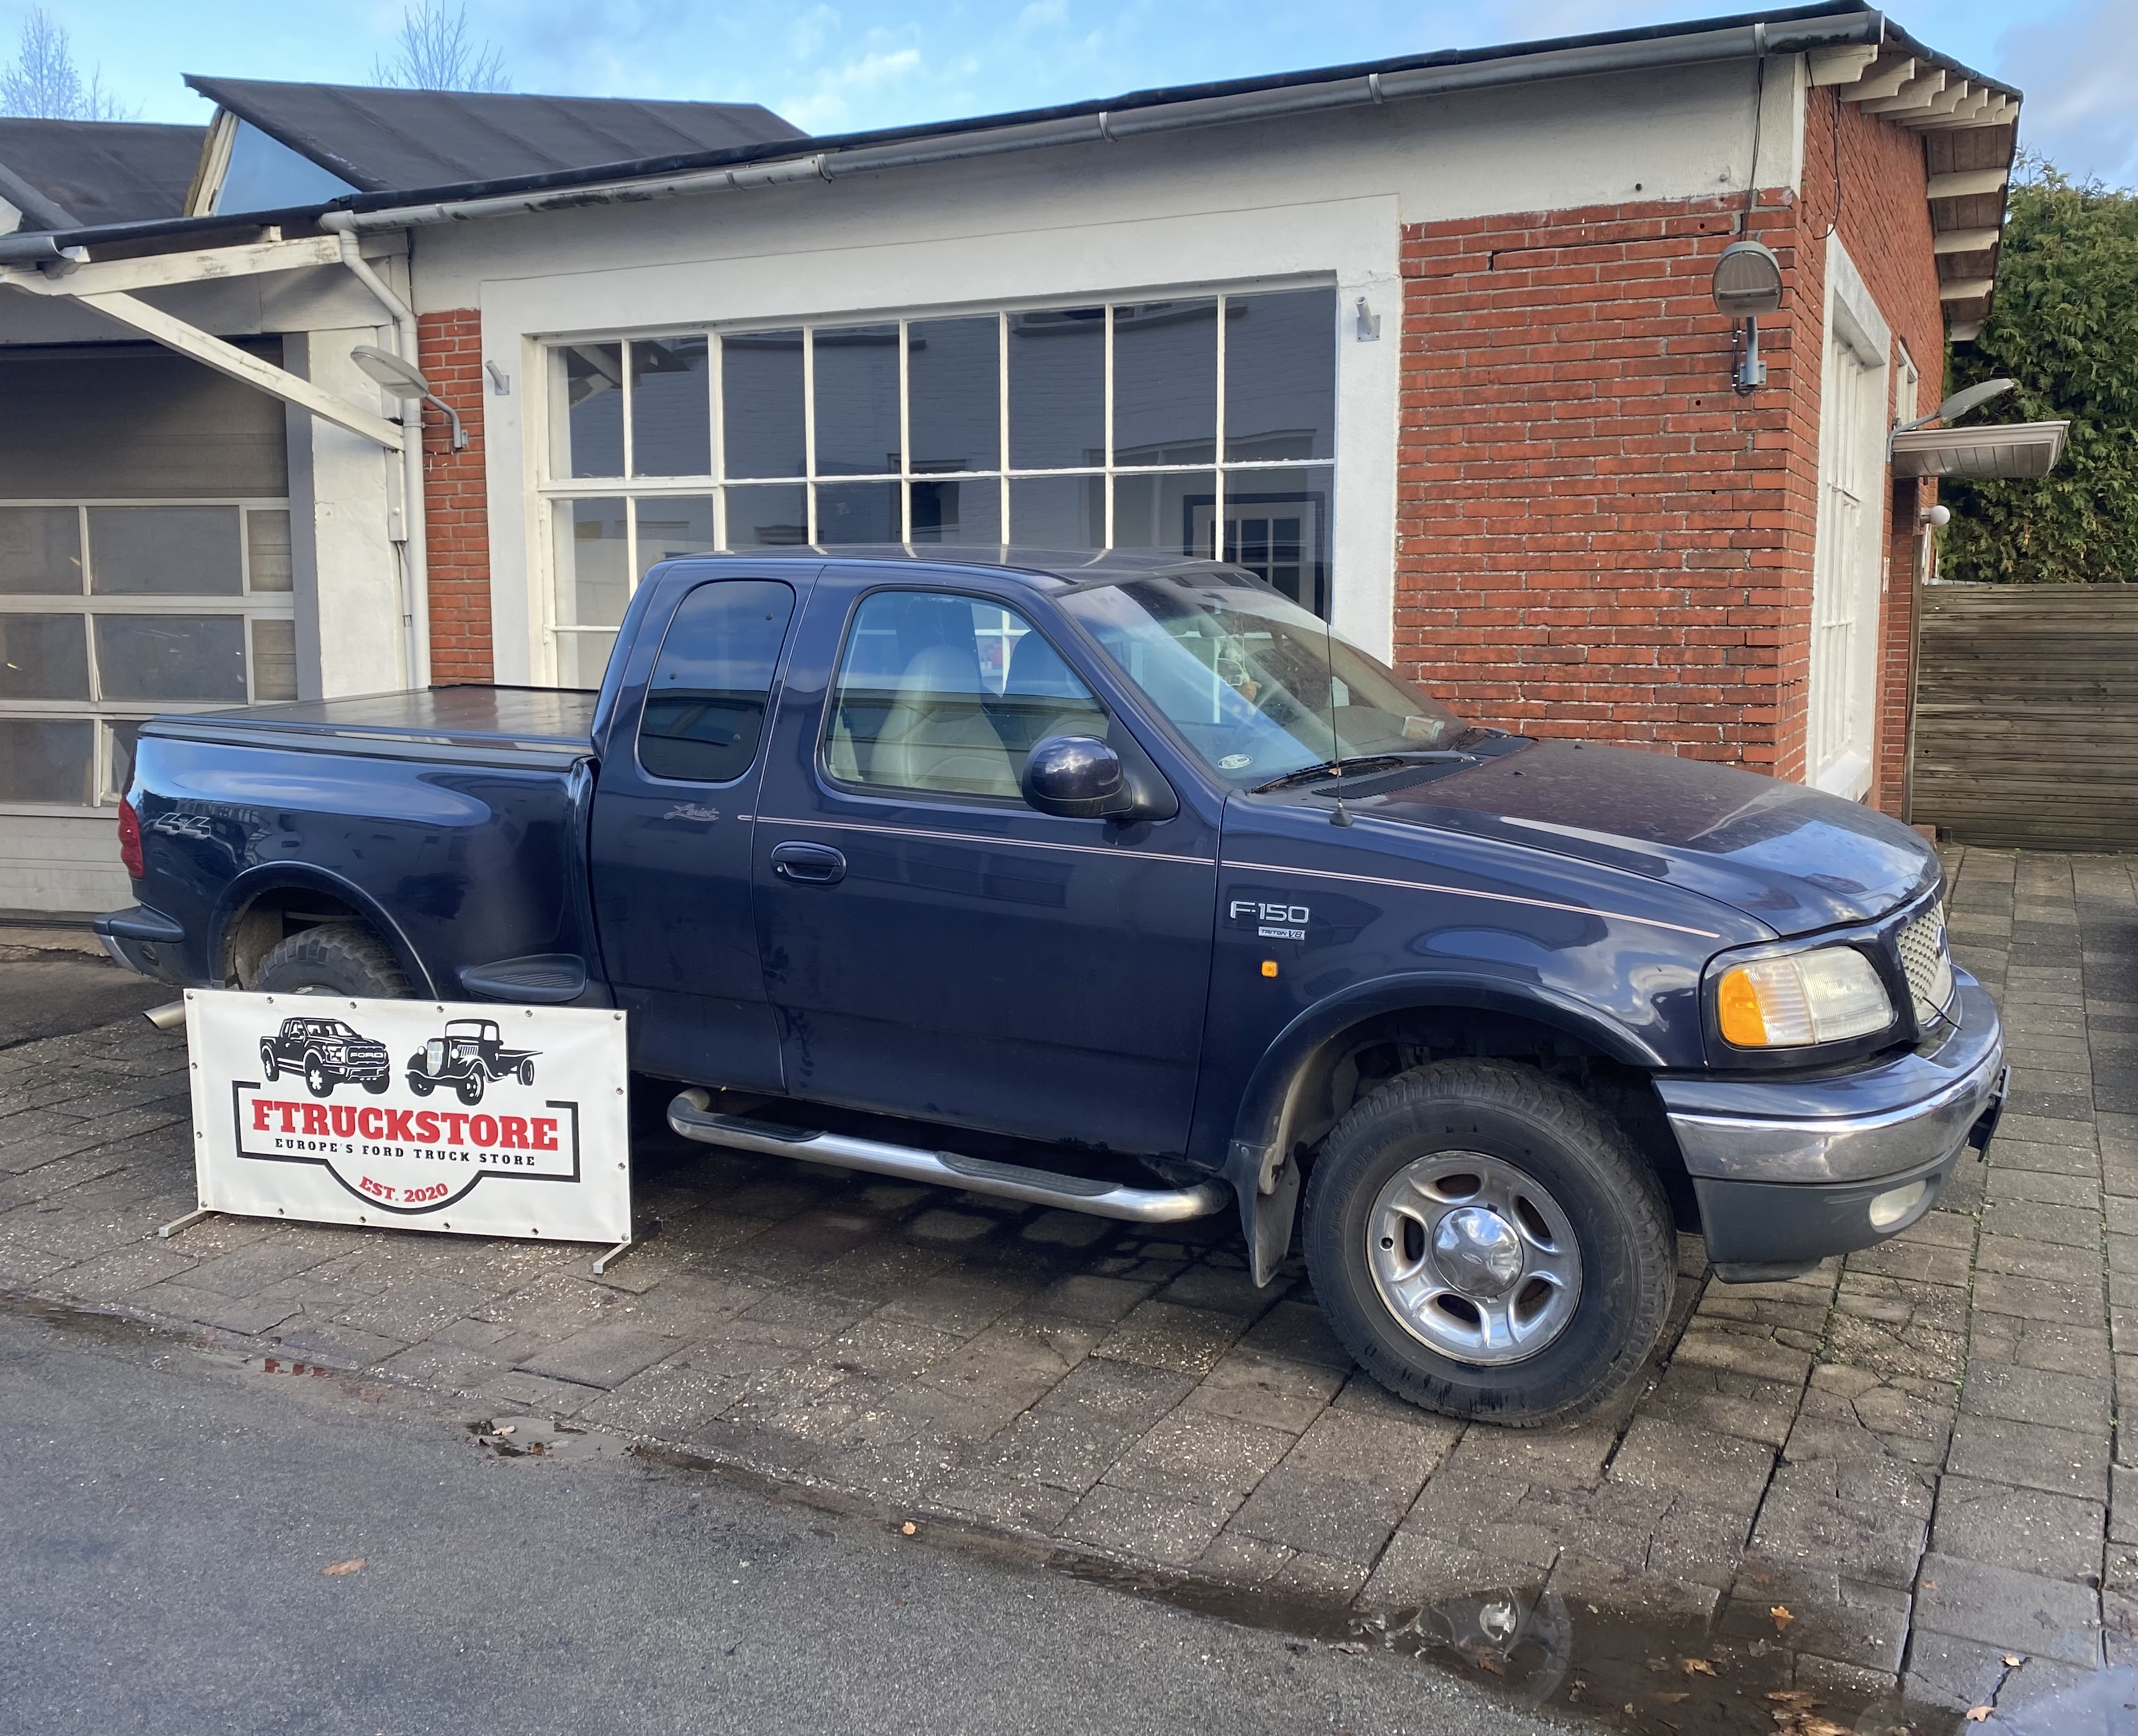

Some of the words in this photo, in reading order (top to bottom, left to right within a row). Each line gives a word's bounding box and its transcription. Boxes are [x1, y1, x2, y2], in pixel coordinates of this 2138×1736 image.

[1230, 901, 1310, 923] F-150
[1288, 930, 1303, 938] V8
[251, 1099, 558, 1151] FTRUCKSTORE
[275, 1138, 353, 1154] EUROPE'S
[362, 1145, 404, 1157] FORD
[414, 1149, 469, 1162] TRUCK
[479, 1153, 535, 1166] STORE
[359, 1176, 399, 1201] EST.
[404, 1183, 448, 1203] 2020
